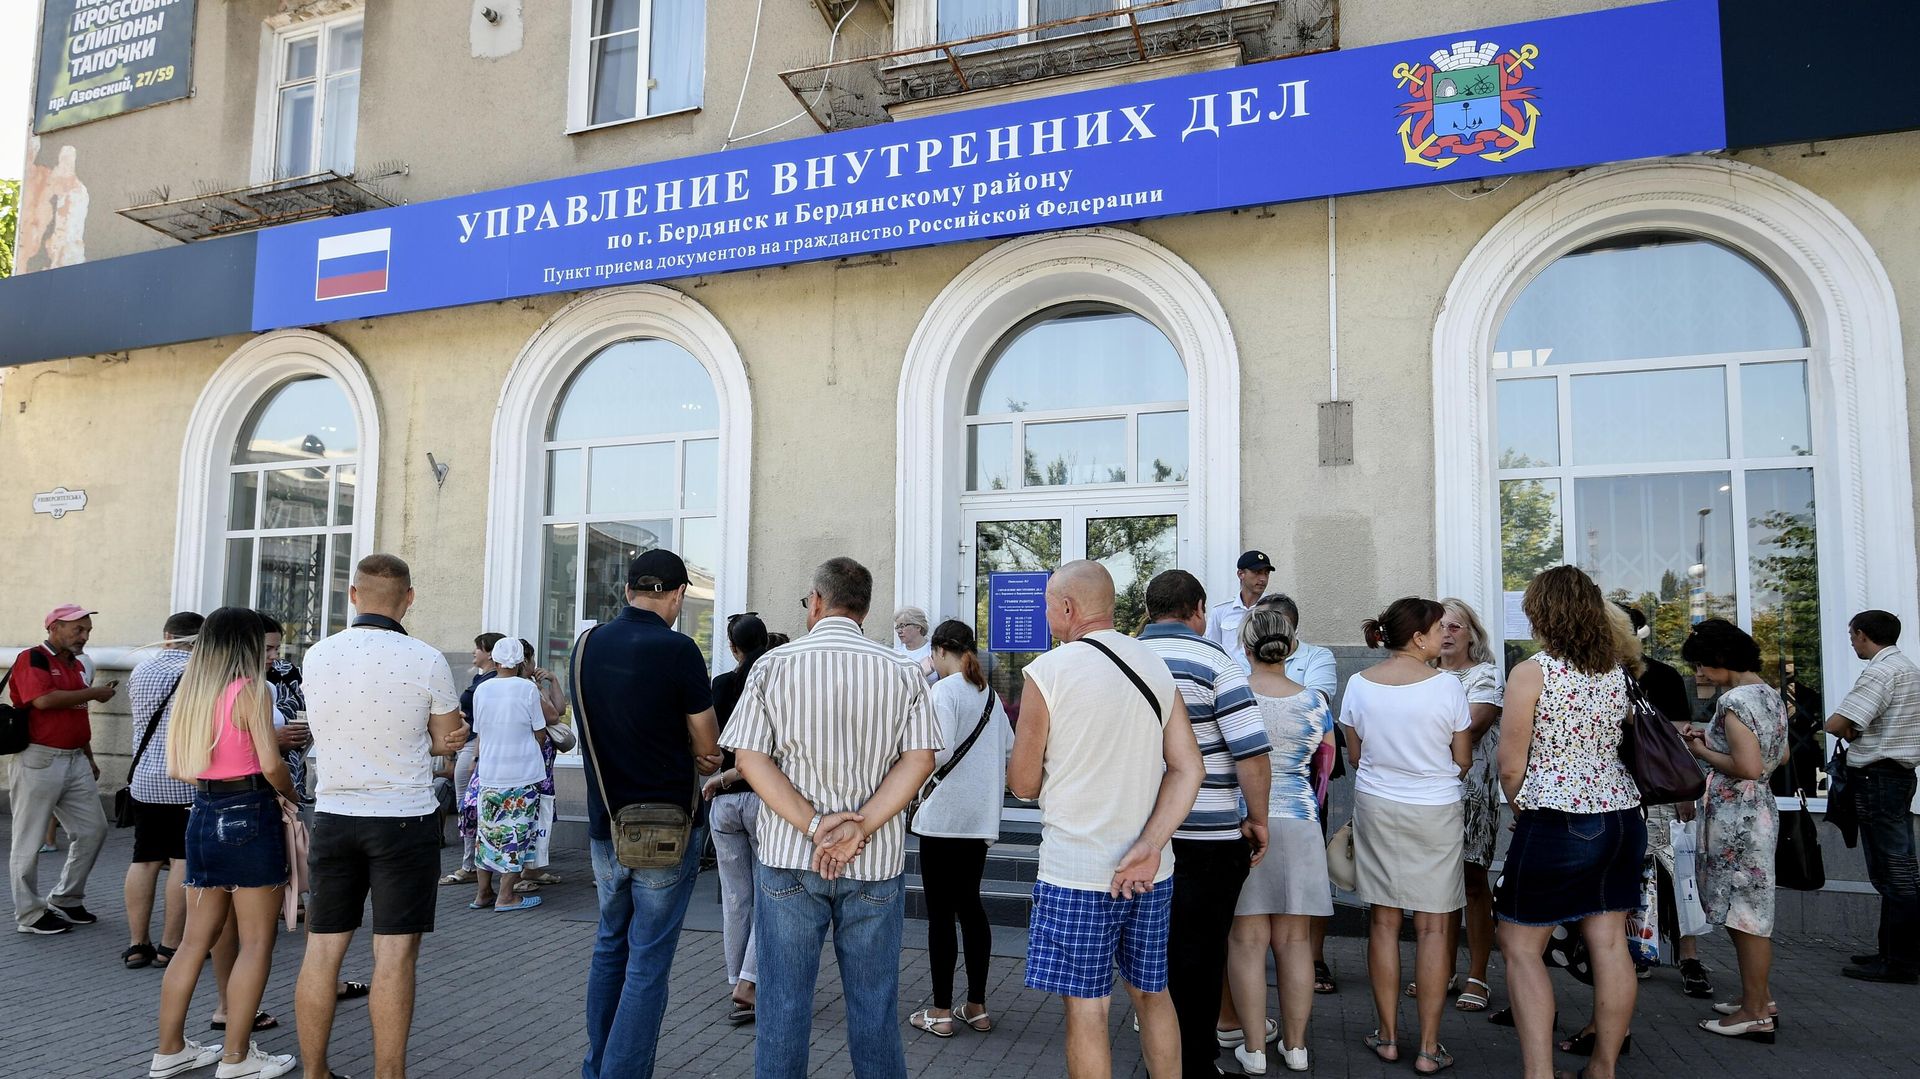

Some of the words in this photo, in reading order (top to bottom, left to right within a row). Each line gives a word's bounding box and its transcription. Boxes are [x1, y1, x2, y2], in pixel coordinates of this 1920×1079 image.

[72, 12, 164, 54] СЛИПОНЫ
[72, 37, 157, 77] ТАПОЧКИ
[48, 97, 68, 111] пр.
[69, 76, 134, 104] Азовский,
[135, 65, 175, 88] 27/59
[456, 168, 750, 244] УПРАВЛЕНИЕ
[770, 103, 1157, 196] ВНУТРЕННИХ
[1181, 79, 1311, 143] ДЕЛ
[543, 266, 592, 286] Пункт
[594, 258, 654, 280] приема
[656, 244, 757, 271] документов
[760, 241, 781, 255] на
[784, 225, 903, 255] гражданство
[907, 202, 1031, 236] Российской
[1036, 189, 1163, 218] Федерации
[607, 233, 633, 250] по
[637, 231, 653, 246] г.
[657, 211, 769, 245] Бердянск
[774, 211, 789, 227] и
[794, 184, 966, 224] Бердянскому
[972, 169, 1073, 205] району
